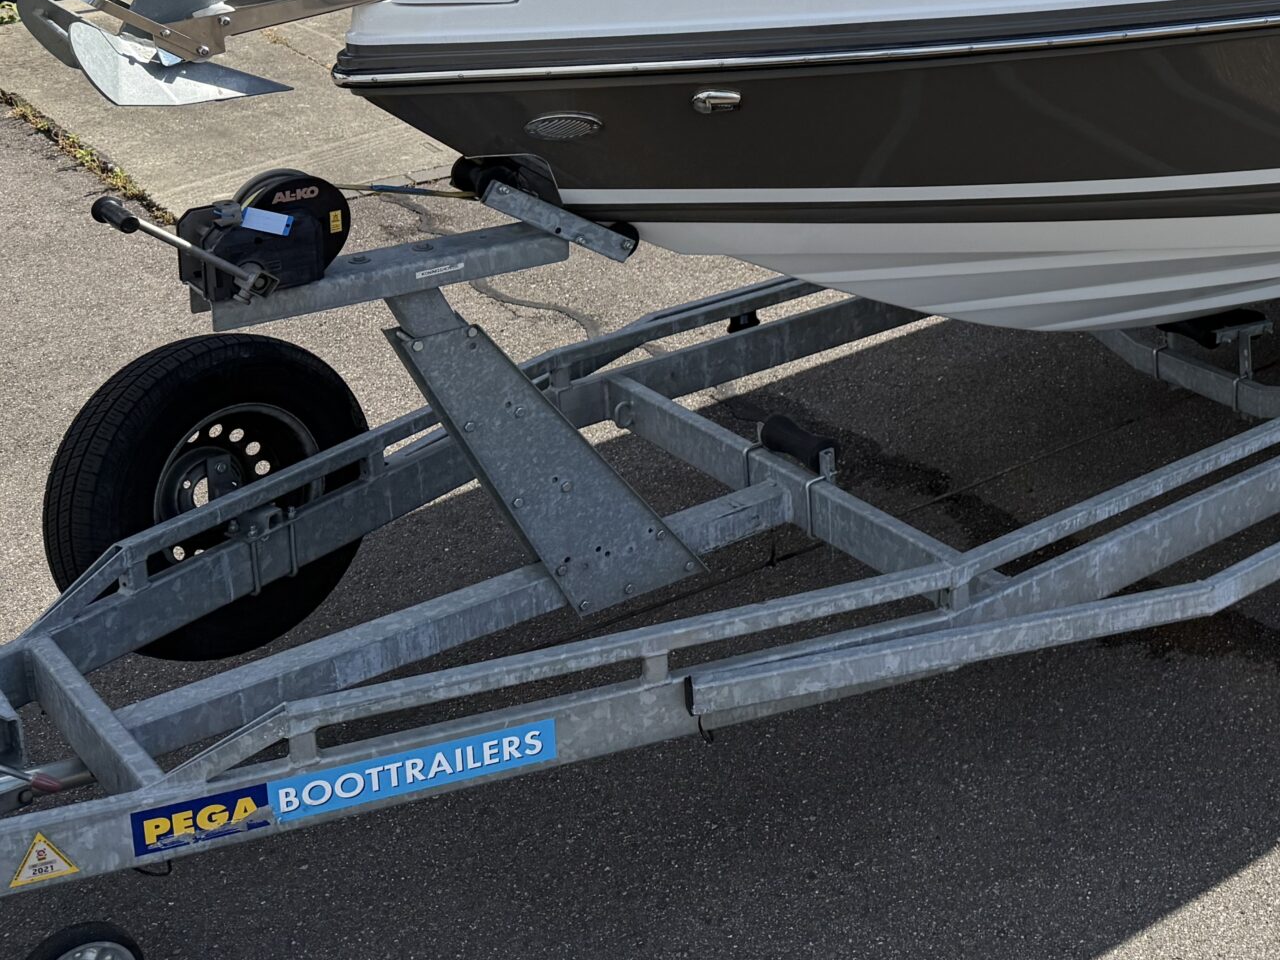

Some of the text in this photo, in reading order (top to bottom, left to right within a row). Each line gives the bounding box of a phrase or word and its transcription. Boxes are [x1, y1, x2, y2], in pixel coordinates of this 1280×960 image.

[271, 185, 320, 205] AL-KO
[143, 730, 545, 846] PEGA BOOTTRAILERS
[32, 865, 54, 876] 2021
